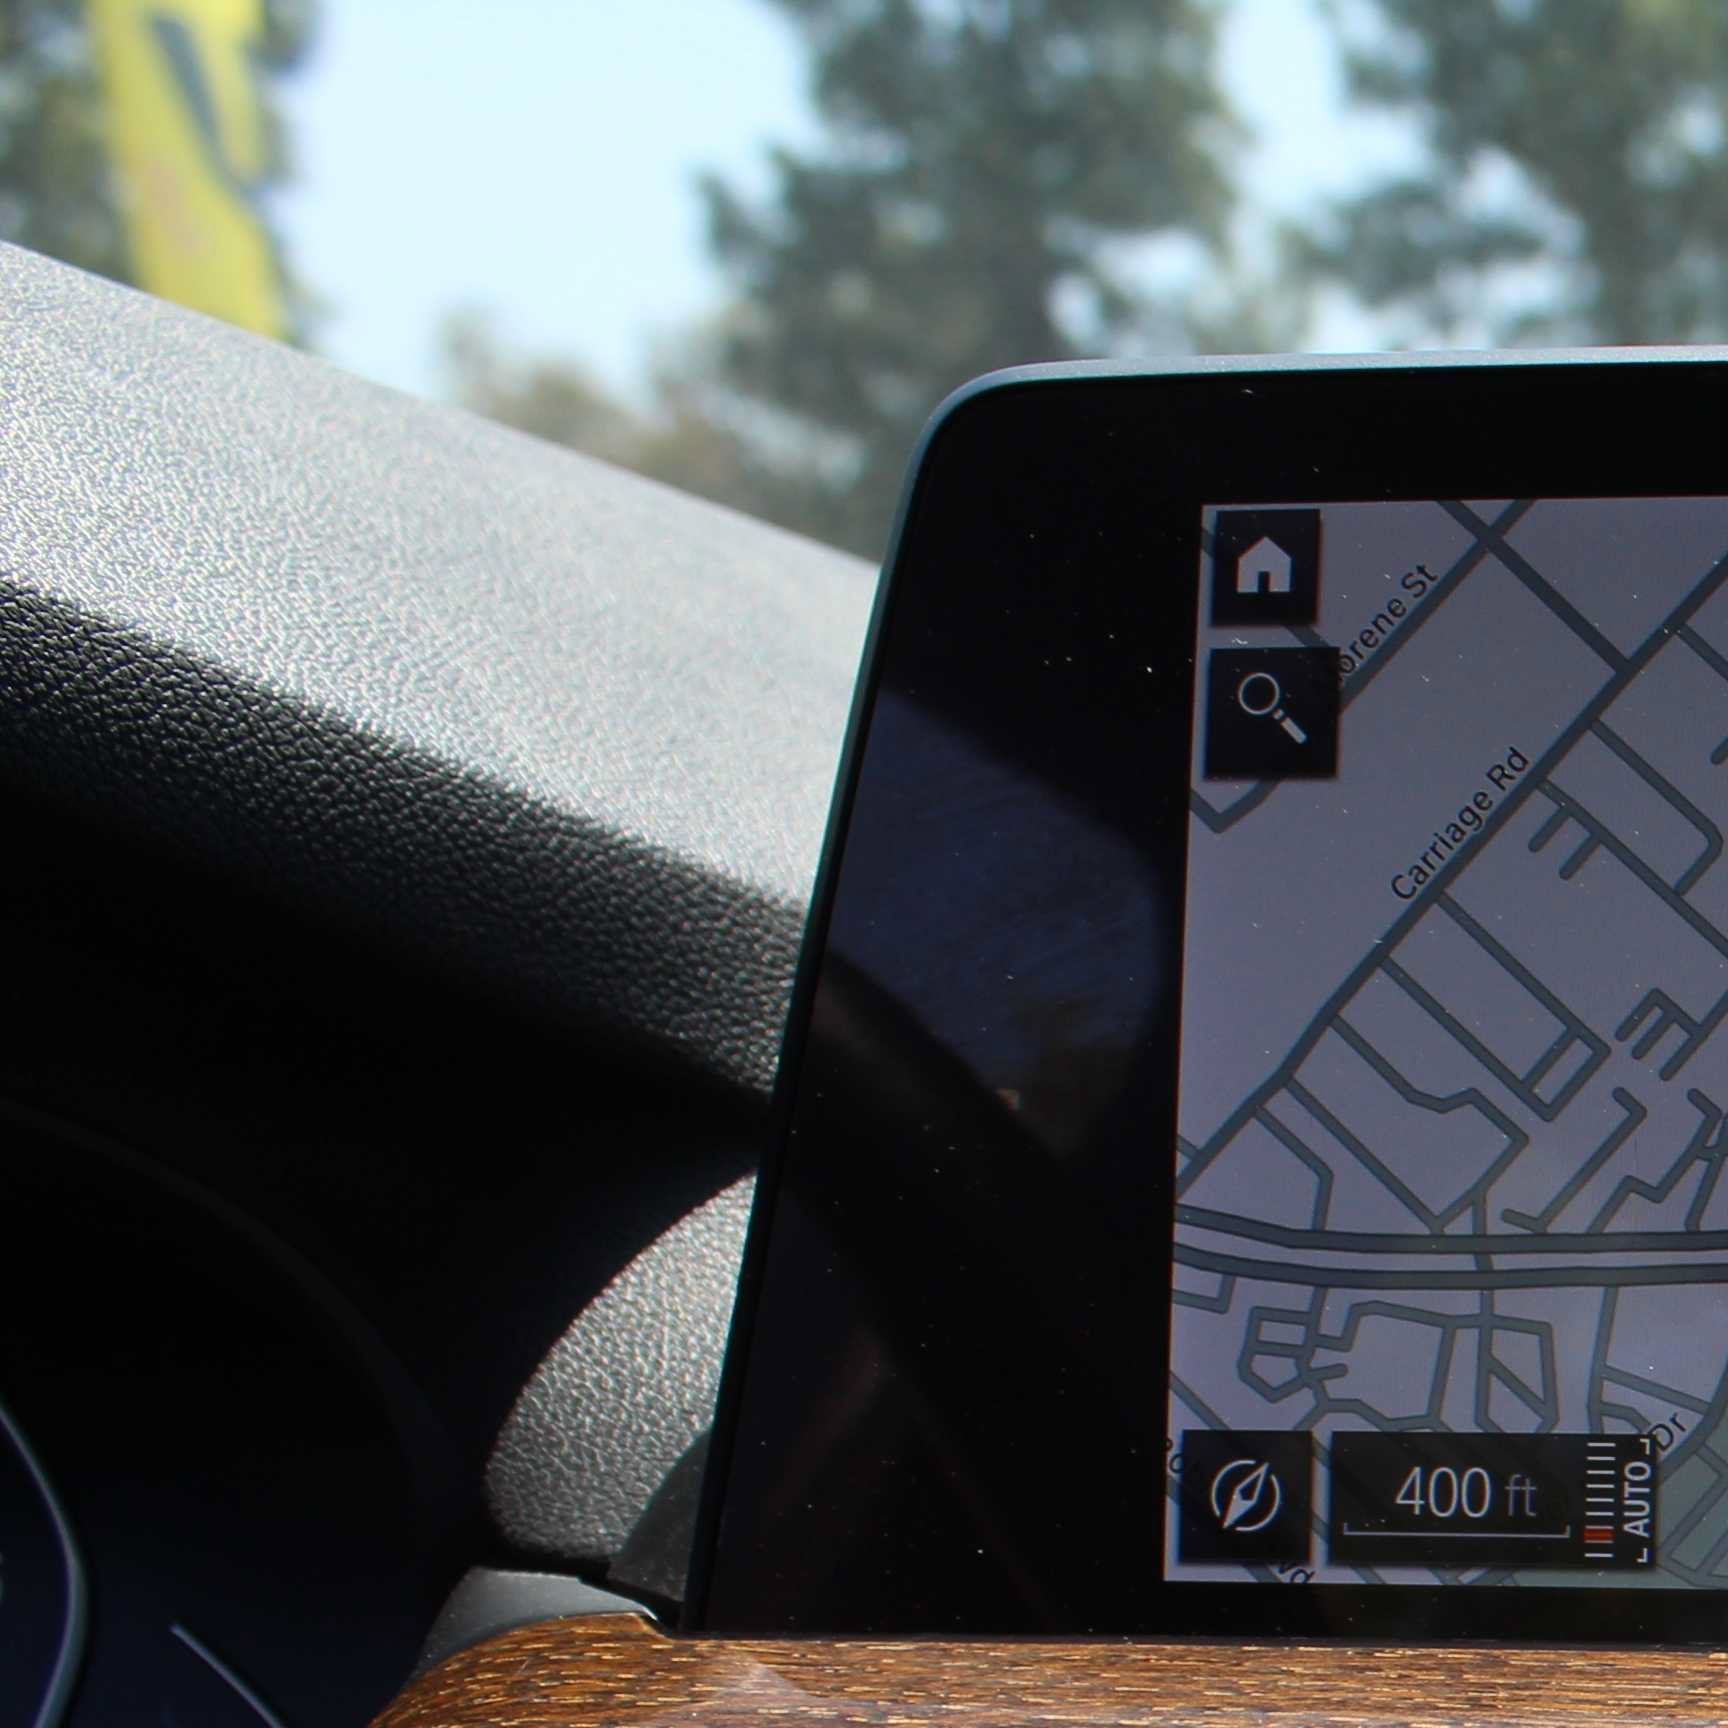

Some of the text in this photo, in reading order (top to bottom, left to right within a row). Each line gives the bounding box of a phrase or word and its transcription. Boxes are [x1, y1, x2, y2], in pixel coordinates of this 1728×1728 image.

[1337, 564, 1438, 681] orene St
[1390, 746, 1530, 900] Carriage Rd
[1651, 1412, 1688, 1452] Dr
[1395, 1465, 1538, 1518] 400 ft
[1622, 1460, 1651, 1538] AUTO
